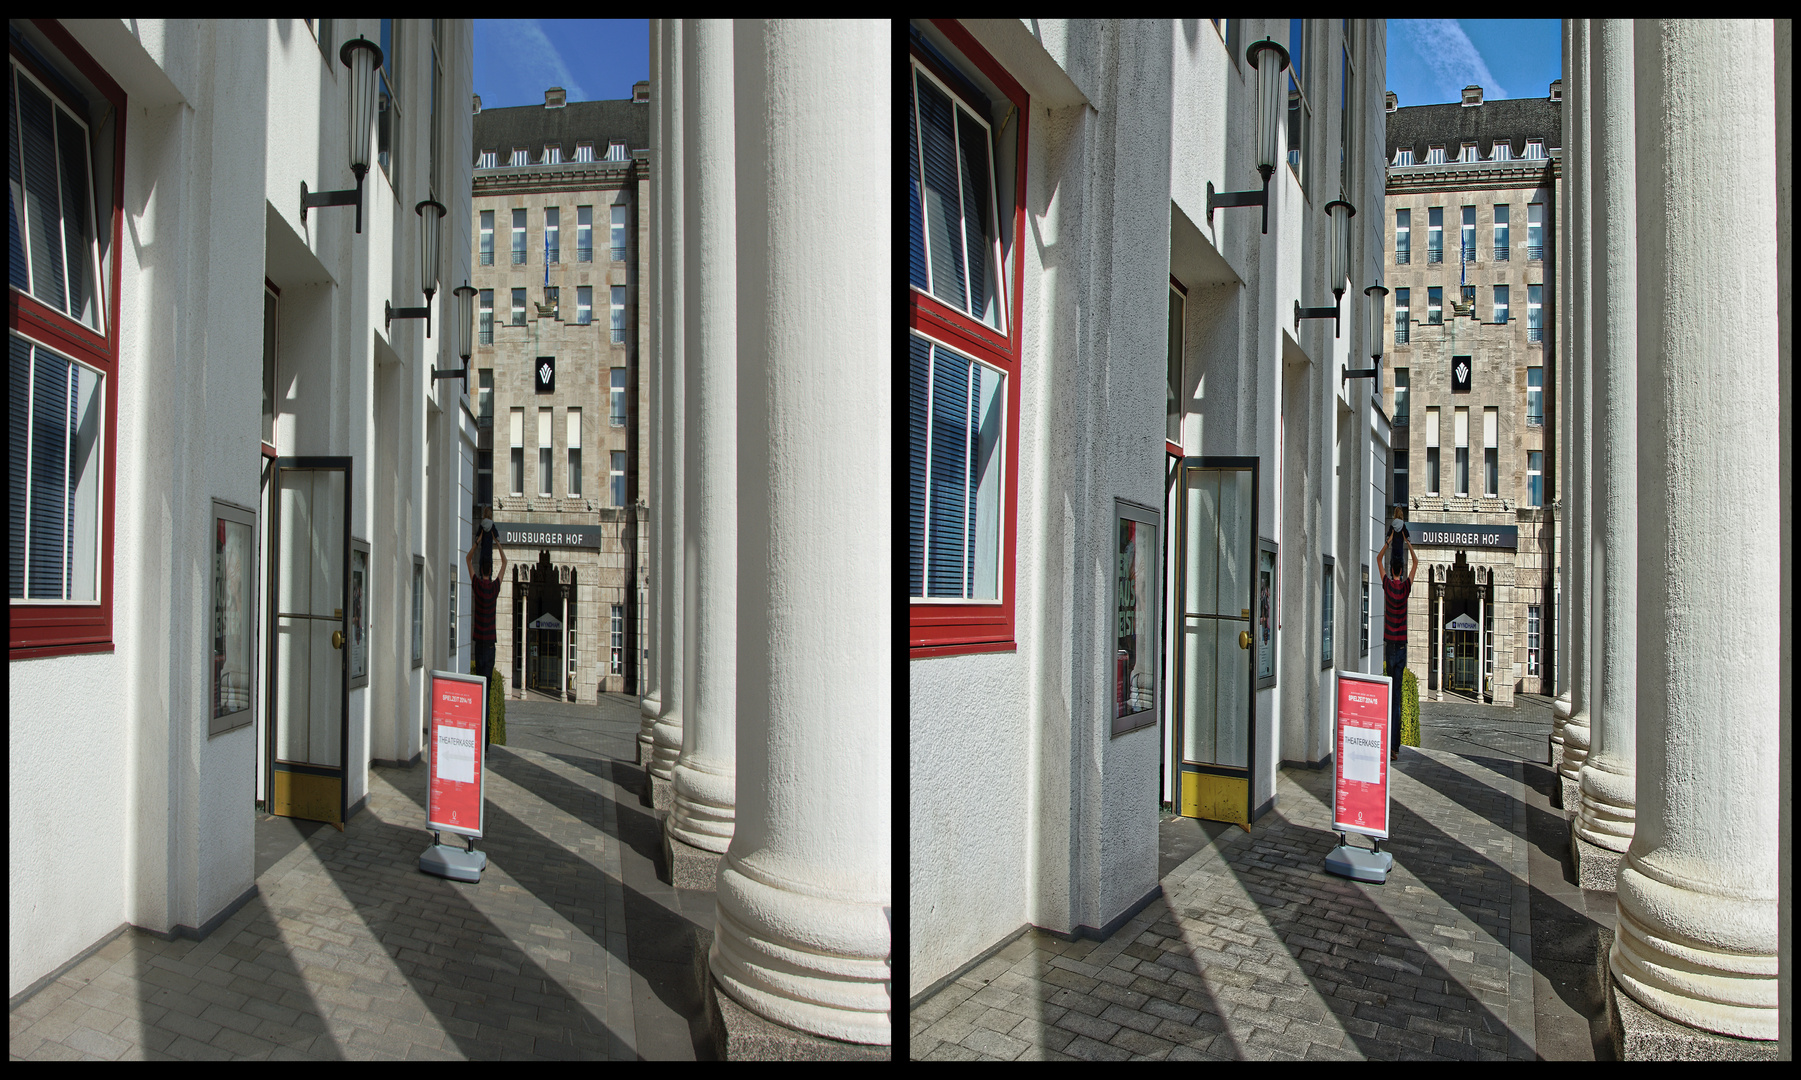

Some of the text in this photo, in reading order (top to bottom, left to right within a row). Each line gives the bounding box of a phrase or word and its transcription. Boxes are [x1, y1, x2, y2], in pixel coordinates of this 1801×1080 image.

[506, 531, 563, 544] DUISBURGER
[565, 533, 583, 545] HOF
[1422, 531, 1500, 545] DUISBURGER HOF
[540, 620, 560, 628] WYNDHAM
[439, 735, 474, 749] THEATERKASSE
[1345, 735, 1380, 749] THEATERKASSE
